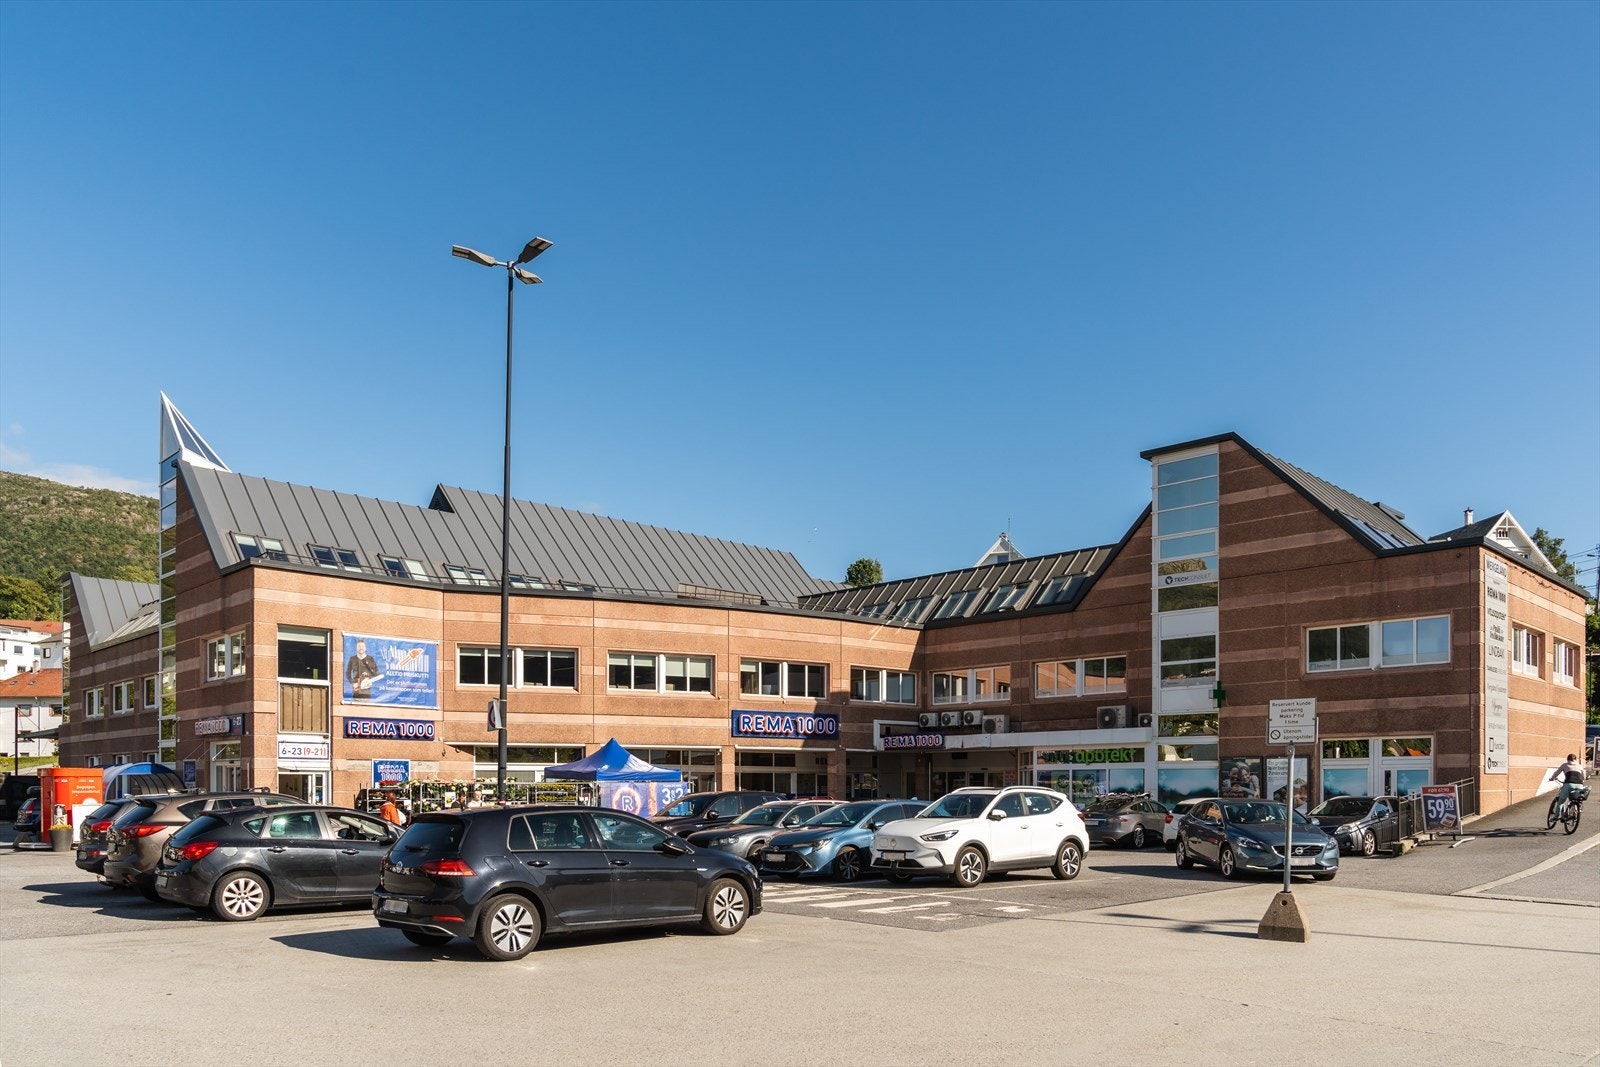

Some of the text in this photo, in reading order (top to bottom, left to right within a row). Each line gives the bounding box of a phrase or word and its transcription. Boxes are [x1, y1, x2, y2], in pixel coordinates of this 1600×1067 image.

[348, 720, 434, 737] REMA 1000
[739, 713, 835, 734] REMA 1000
[884, 734, 943, 748] REMA 1000
[281, 747, 302, 756] 6-23
[377, 764, 406, 774] REMA
[621, 795, 634, 811] R
[662, 788, 671, 805] 3
